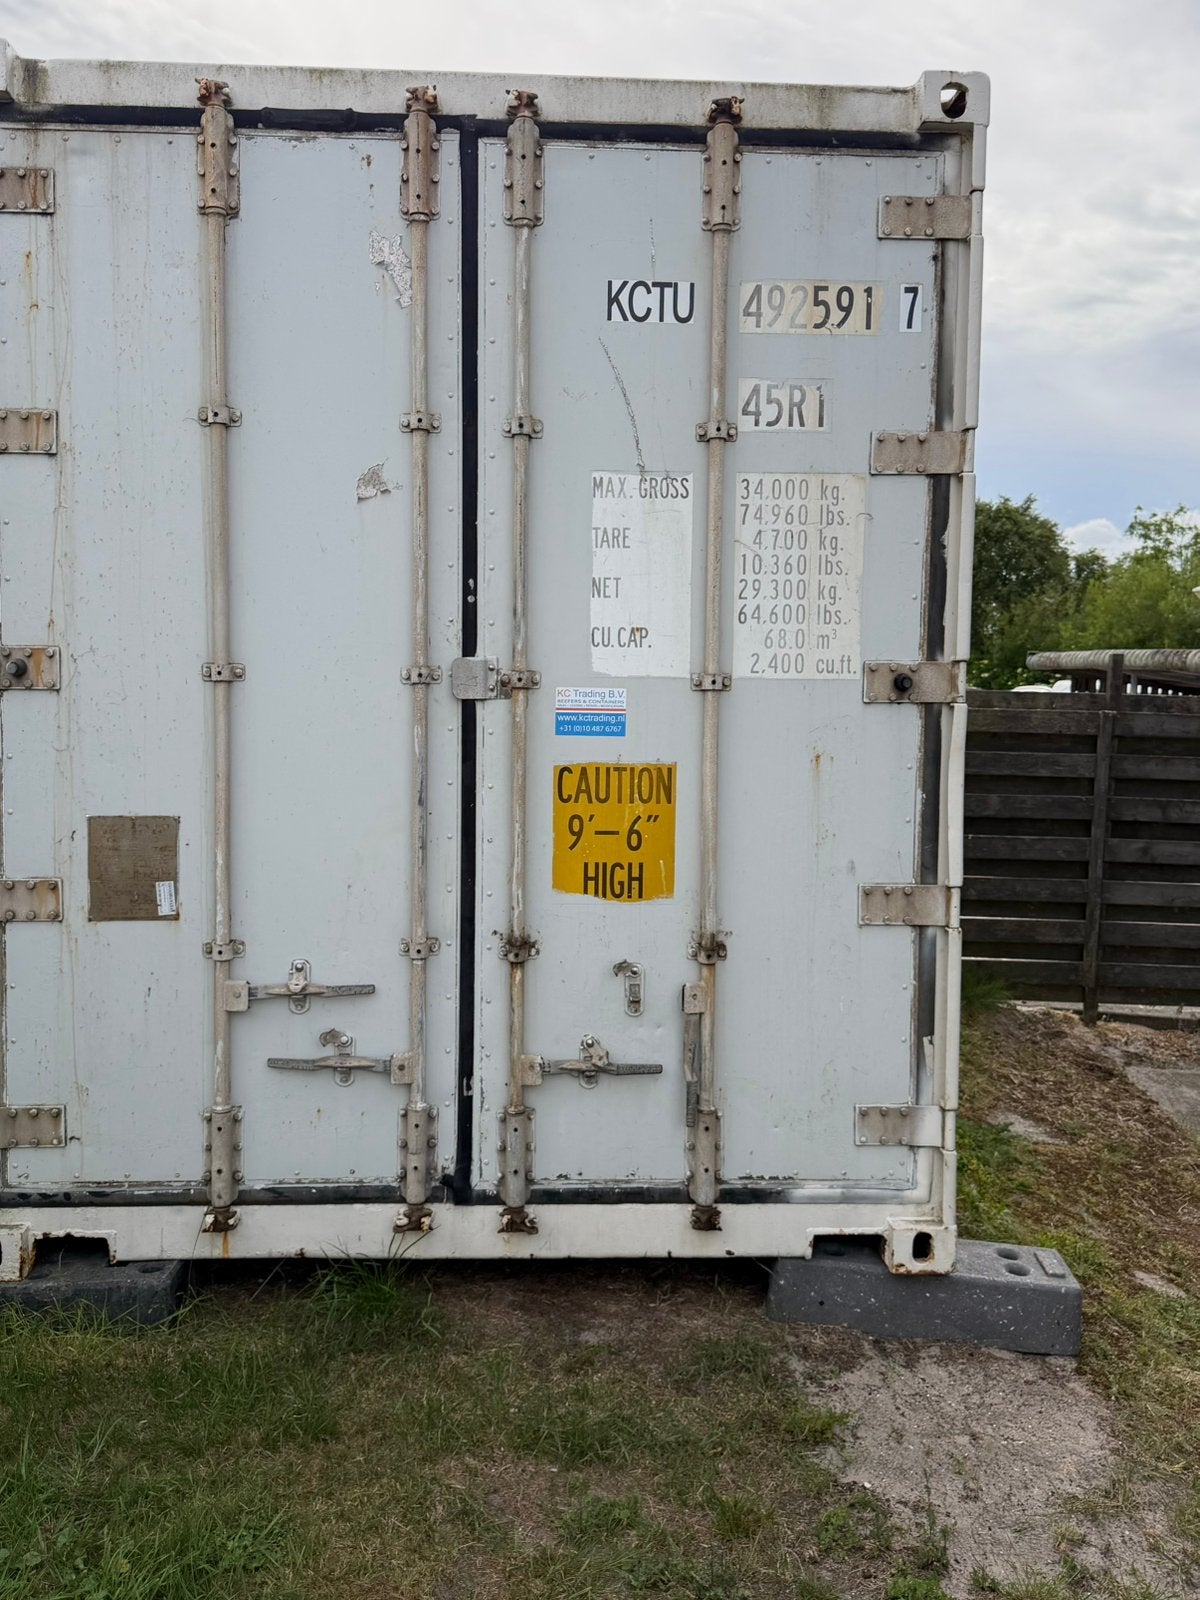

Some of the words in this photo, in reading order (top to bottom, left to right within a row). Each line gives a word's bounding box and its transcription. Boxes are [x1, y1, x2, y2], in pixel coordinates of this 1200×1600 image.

[607, 280, 695, 323] KCTU
[742, 284, 873, 331] 492591
[903, 286, 919, 329] 7
[742, 384, 825, 427] 45R1
[593, 477, 633, 499] MAX.
[639, 478, 689, 499] GROSS
[820, 479, 845, 506] kg.
[820, 504, 850, 526] lbs.
[593, 527, 631, 549] TARE
[819, 530, 844, 556] kg.
[818, 554, 848, 576] lbs.
[592, 577, 622, 598] NET
[818, 580, 842, 606] kg.
[817, 604, 848, 625] lbs.
[764, 629, 805, 650] 68.0
[557, 689, 571, 698] KC
[573, 689, 606, 700] Trading
[608, 690, 625, 698] B.V.
[557, 713, 625, 724] www.kctrading.nl
[573, 725, 591, 733] (0)10
[557, 766, 673, 804] CAUTION
[583, 862, 644, 899] HIGH
